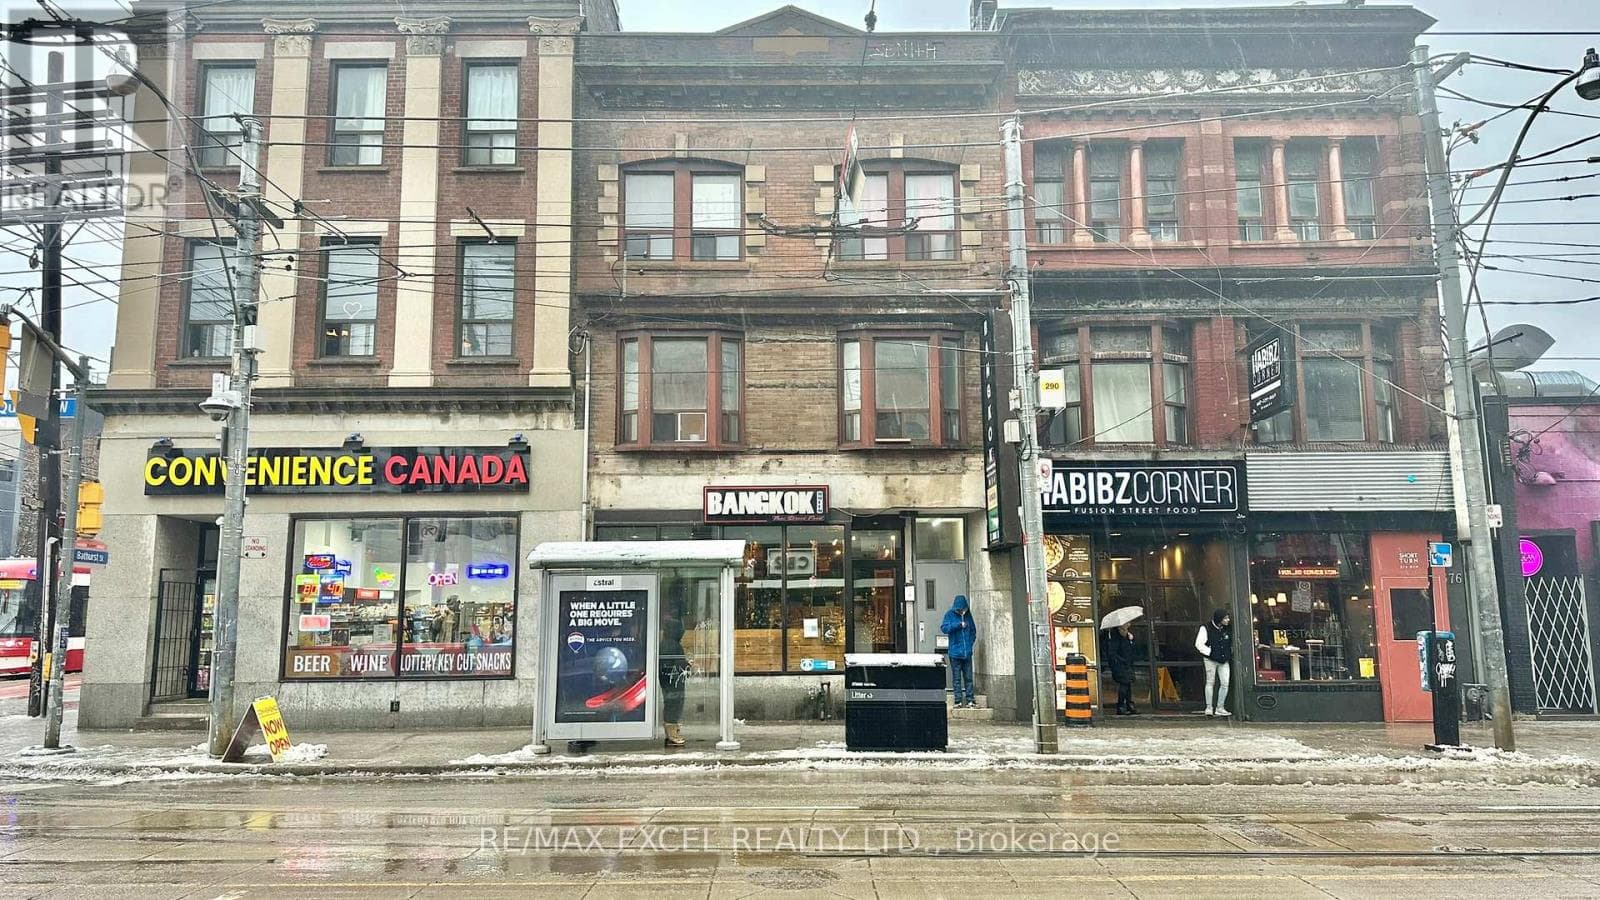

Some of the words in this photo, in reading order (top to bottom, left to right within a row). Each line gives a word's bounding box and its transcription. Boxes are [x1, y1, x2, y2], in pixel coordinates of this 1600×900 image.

[1251, 341, 1280, 376] HABIBZ
[1045, 382, 1060, 390] 290
[384, 454, 528, 485] CANADA
[707, 491, 815, 515] BANGKOK
[1074, 506, 1115, 514] FUSION
[428, 572, 457, 586] OPEN
[569, 610, 588, 618] ONE
[589, 610, 633, 618] REQUIRES
[570, 602, 597, 610] WHEN
[597, 602, 605, 610] A
[606, 601, 636, 609] LITTLE
[569, 618, 577, 626] A
[577, 618, 592, 626] BIG
[594, 618, 622, 626] MOVE.
[293, 655, 331, 673] BEER
[350, 654, 388, 673] WINE
[400, 654, 437, 672] LOTTERY
[437, 654, 453, 671] KEY
[456, 653, 474, 671] CUT
[476, 652, 511, 671] SNACKS
[263, 717, 283, 737] NOW
[269, 735, 292, 756] OPEN
